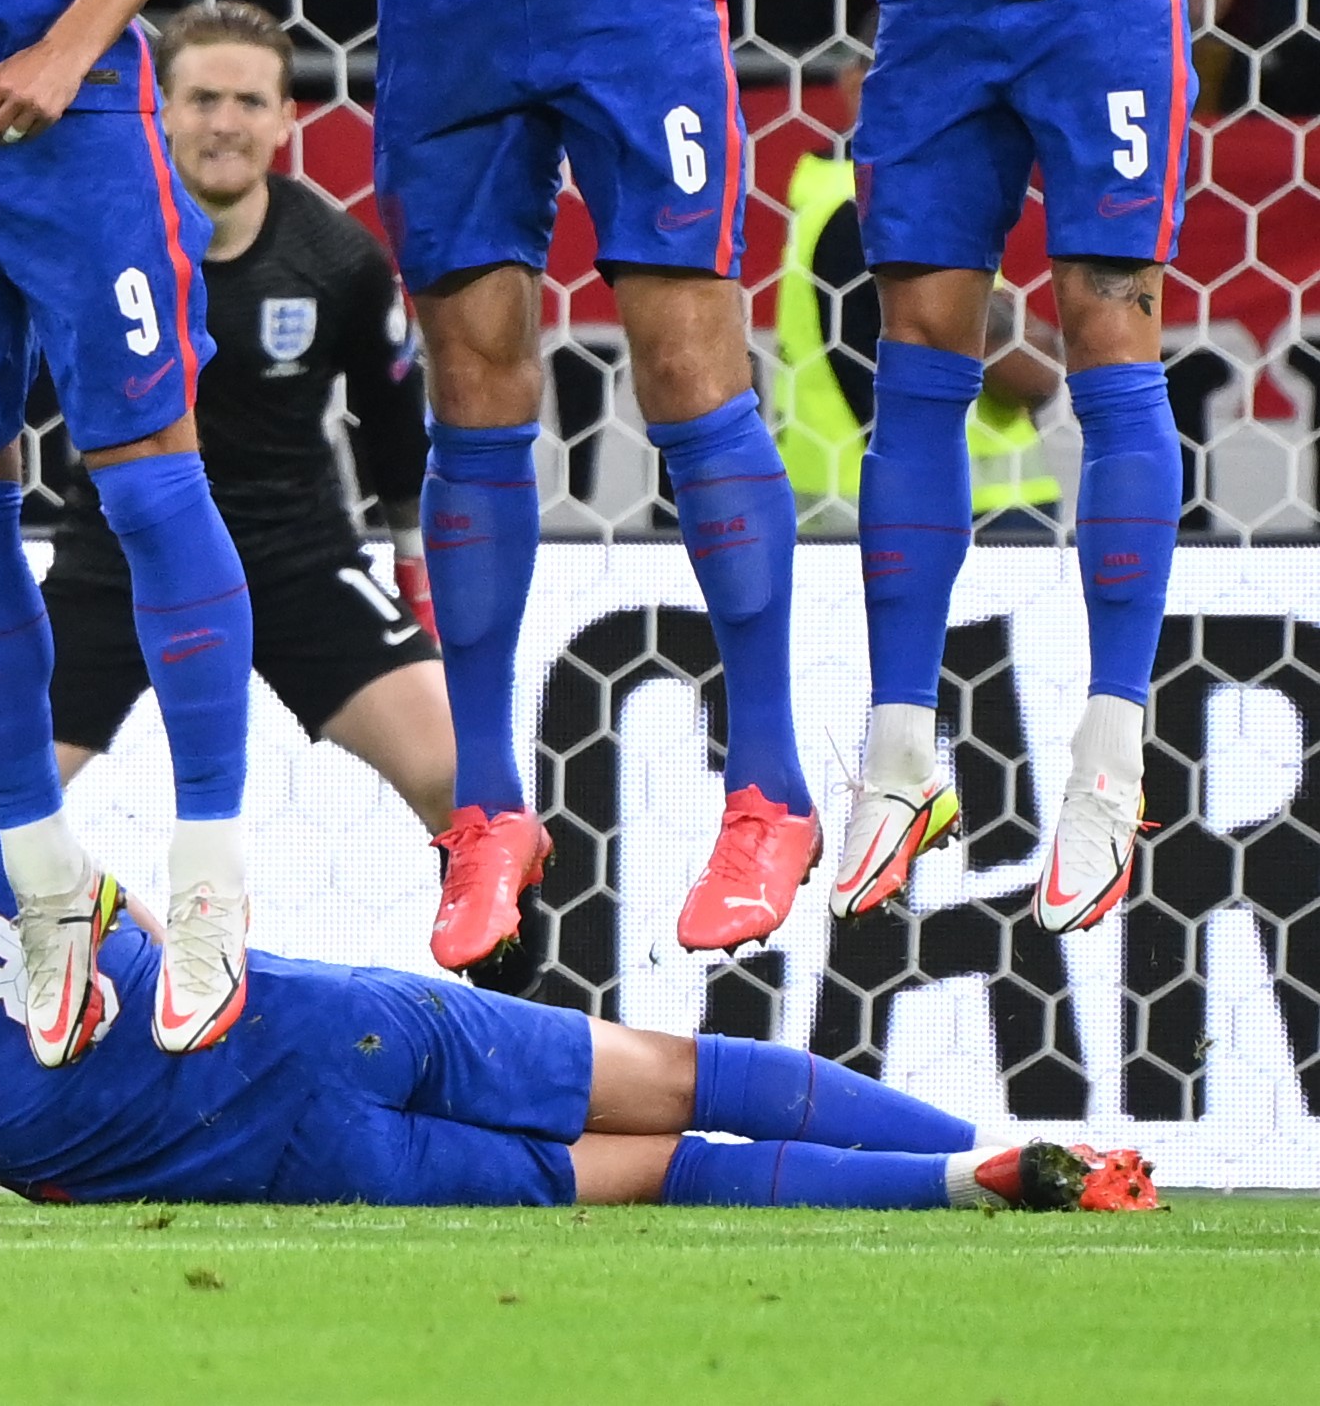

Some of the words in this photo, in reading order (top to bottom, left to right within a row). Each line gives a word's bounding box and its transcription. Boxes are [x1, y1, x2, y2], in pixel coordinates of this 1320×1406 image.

[663, 105, 707, 195] 6
[1107, 90, 1149, 180] 5
[114, 267, 159, 356] 9
